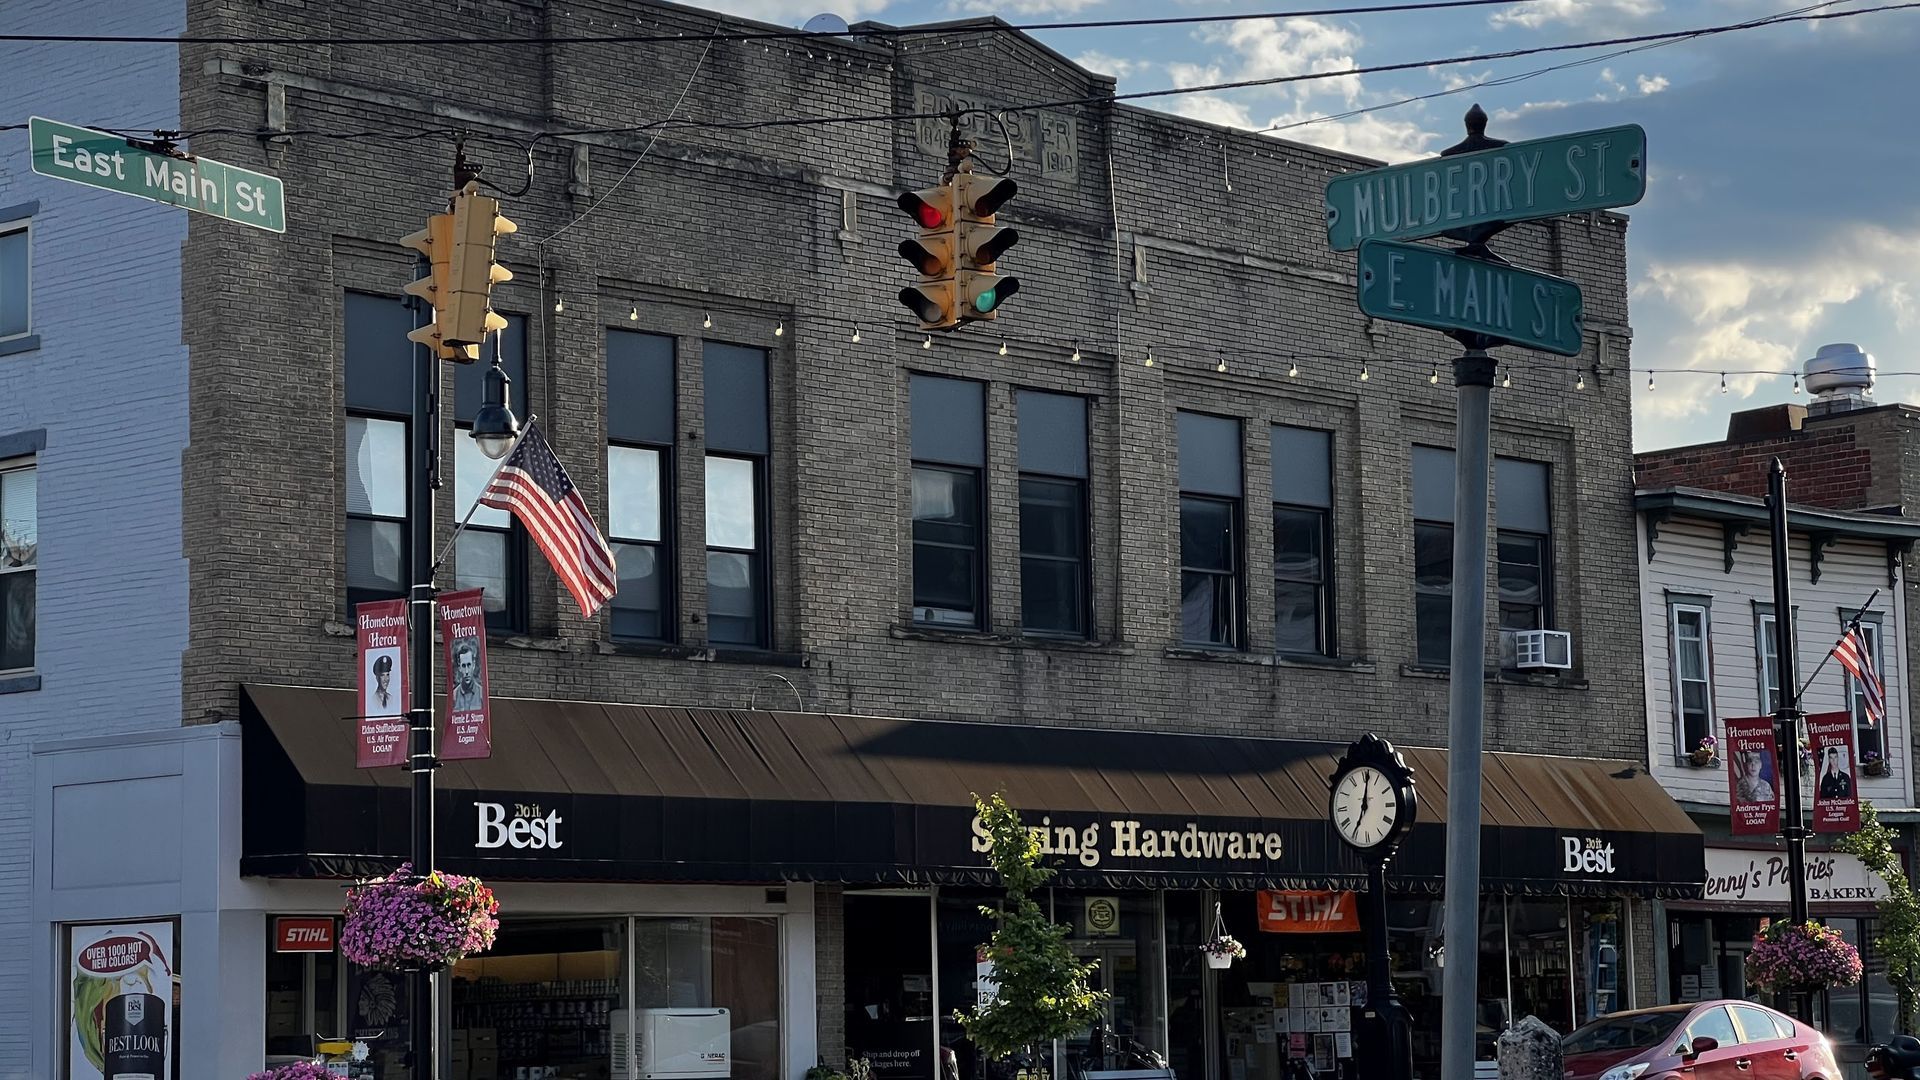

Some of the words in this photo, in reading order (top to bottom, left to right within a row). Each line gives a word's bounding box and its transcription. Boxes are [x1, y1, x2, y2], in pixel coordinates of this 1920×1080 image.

[52, 134, 126, 181] East
[144, 156, 218, 204] Main
[235, 181, 266, 216] St
[1354, 150, 1543, 237] MULBERRY
[1388, 252, 1415, 311] E.
[1434, 261, 1512, 330] MAIN
[441, 604, 482, 620] Hometown
[359, 614, 405, 630] Hometown
[456, 726, 466, 734] U.S.
[466, 725, 479, 735] Army
[1727, 726, 1772, 739] Hometown
[1808, 722, 1850, 735] Hometown
[366, 735, 376, 744] U.S.
[384, 734, 399, 742] Force
[458, 736, 475, 745] Logan
[372, 744, 392, 753] LOGAN
[514, 803, 530, 818] Do
[531, 803, 542, 818] it
[1735, 804, 1761, 812] Andrew
[1761, 803, 1775, 812] Frye
[473, 802, 563, 849] Best
[1110, 820, 1283, 860] Hardware
[1585, 837, 1596, 849] Do
[1595, 837, 1602, 849] it
[1562, 836, 1616, 874] Best
[1766, 856, 1835, 887] Paries
[1810, 887, 1878, 900] BAKERY
[1268, 895, 1343, 921] STIHL
[286, 927, 329, 942] STIHL
[86, 947, 106, 960] OVER
[108, 943, 126, 957] 1000
[127, 941, 143, 953] HOT
[91, 958, 108, 970] NEW
[108, 954, 138, 968] COLORS!
[109, 1035, 130, 1053] BEST
[133, 1035, 160, 1053] LOOK
[879, 1050, 892, 1058] and
[892, 1050, 910, 1059] drop
[910, 1049, 921, 1057] off
[871, 1060, 893, 1069] ckages
